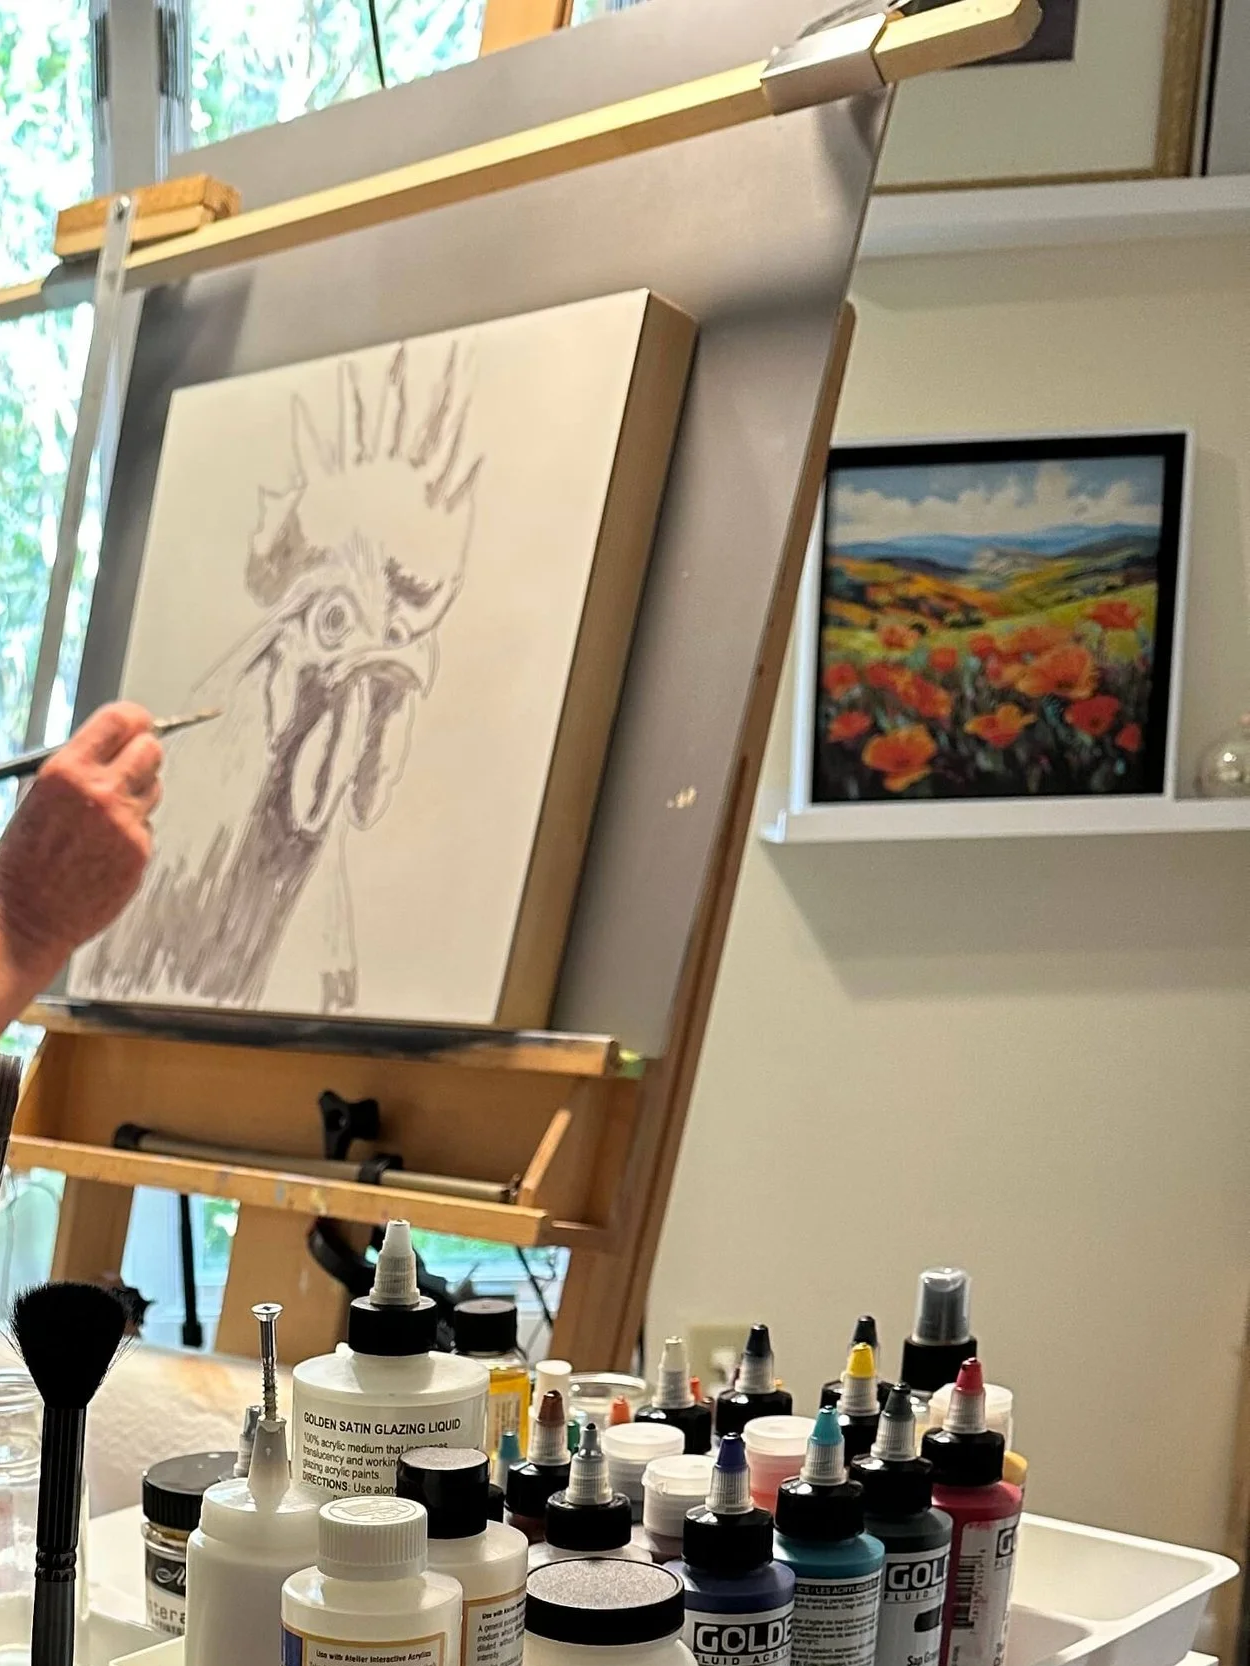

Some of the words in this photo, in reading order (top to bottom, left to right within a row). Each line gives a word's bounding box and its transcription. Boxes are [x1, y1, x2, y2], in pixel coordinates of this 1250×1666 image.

[304, 1412, 337, 1429] GOLDEN
[340, 1420, 371, 1434] SATIN
[375, 1424, 425, 1434] GLAZING
[429, 1419, 461, 1433] LIQUID
[304, 1432, 319, 1445] 100%
[321, 1439, 345, 1451] acrylic
[348, 1444, 383, 1454] medium
[386, 1444, 405, 1454] that
[303, 1445, 344, 1465] translucency
[346, 1456, 363, 1465] and
[303, 1459, 322, 1474] glazing
[324, 1463, 350, 1477] acrylic
[302, 1472, 350, 1492] DIRECTIONS:
[354, 1483, 372, 1492] Use
[884, 1589, 928, 1600] FLUID
[696, 1615, 793, 1653] GOLDE
[316, 1650, 327, 1659] Use
[345, 1654, 367, 1663] Atelier
[370, 1654, 405, 1663] Interactive
[408, 1651, 431, 1661] Acrylics
[907, 1655, 922, 1666] Sap
